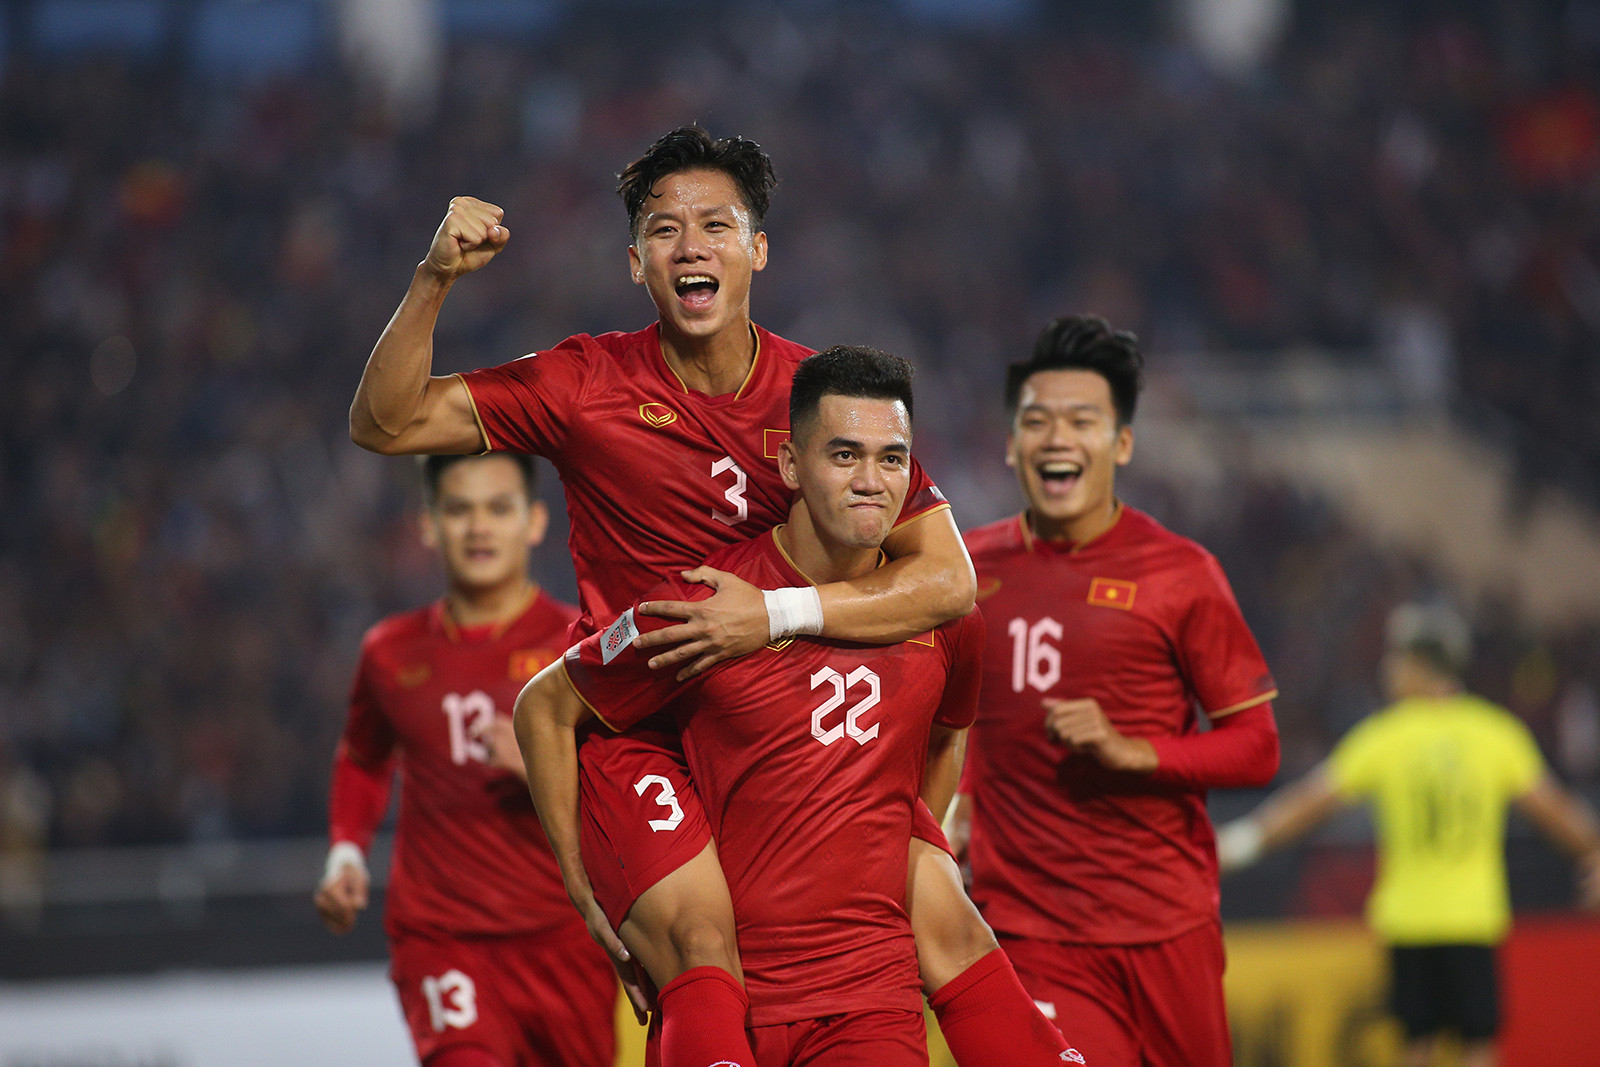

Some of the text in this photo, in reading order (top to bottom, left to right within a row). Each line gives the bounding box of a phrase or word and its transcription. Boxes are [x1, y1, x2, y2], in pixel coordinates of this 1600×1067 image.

[711, 456, 748, 526] 3
[1008, 616, 1064, 693] 16
[442, 690, 495, 765] 13
[810, 664, 881, 747] 22
[633, 774, 685, 833] 3
[422, 970, 478, 1032] 13
